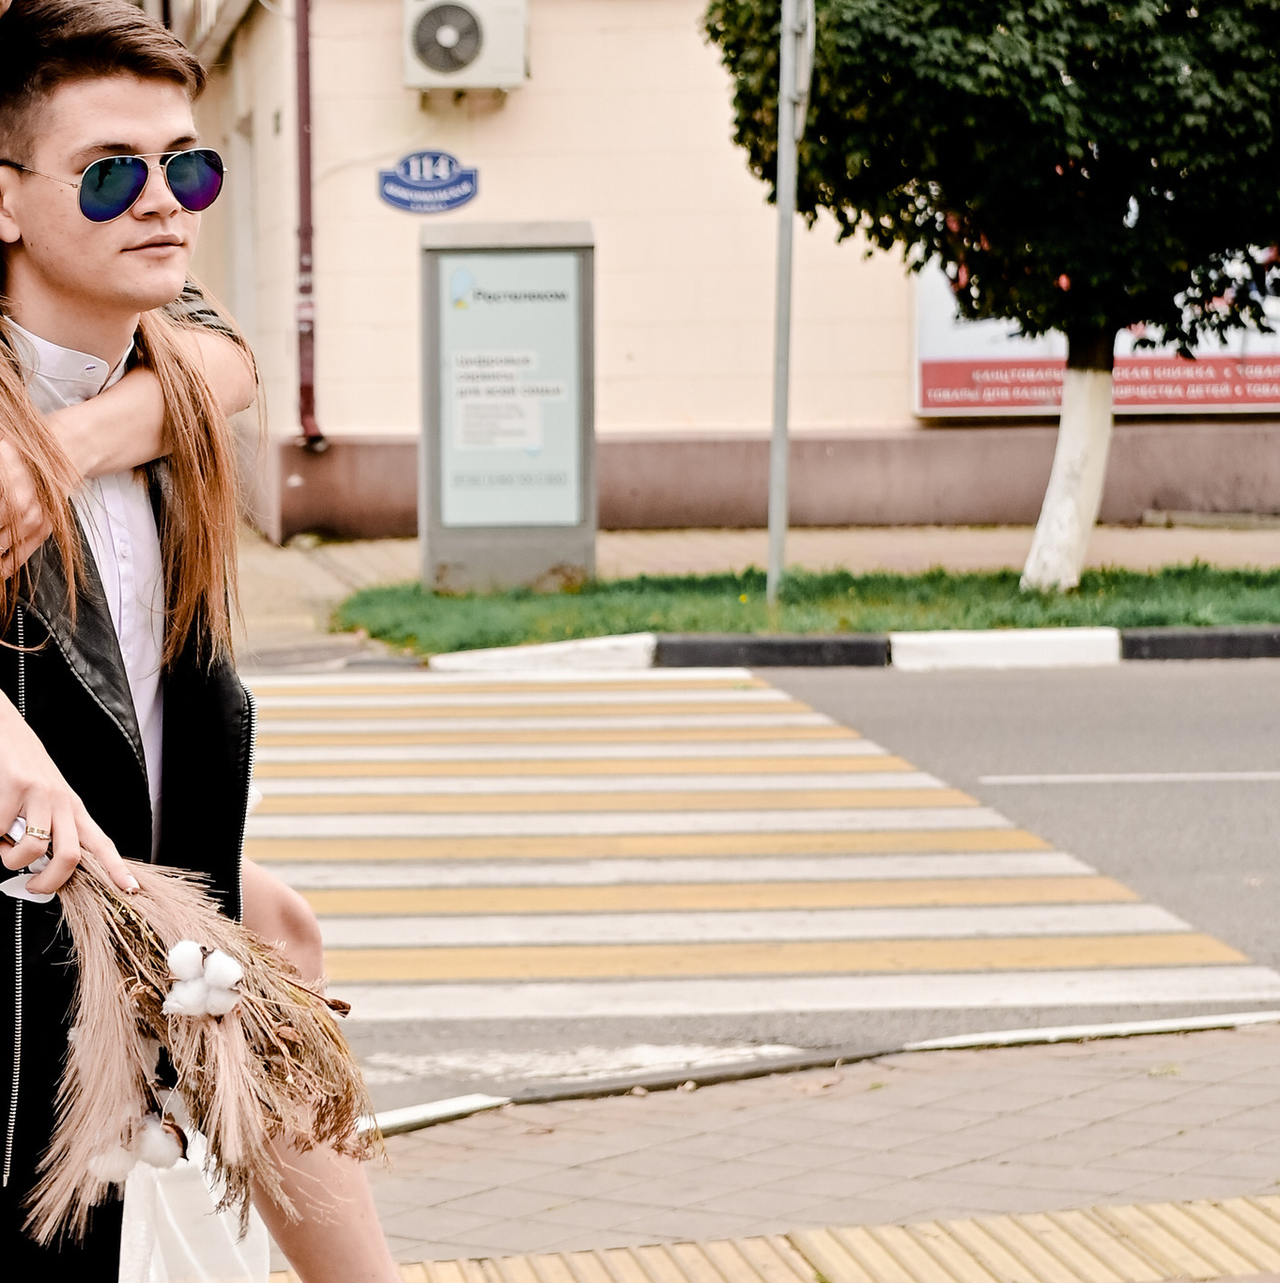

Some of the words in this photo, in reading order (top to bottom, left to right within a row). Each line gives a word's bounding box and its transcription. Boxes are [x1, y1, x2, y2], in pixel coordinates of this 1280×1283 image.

[408, 155, 451, 181] 114
[472, 288, 568, 304] Ростелеком
[1153, 365, 1215, 379] КНИЖКА
[1236, 364, 1280, 378] ТОВАР
[927, 388, 979, 402] ТОВАРЫ
[982, 387, 1010, 402] ДЛЯ
[1012, 386, 1062, 400] РАЗВИТ
[1112, 384, 1184, 399] ОРЧЕСТВА
[1186, 382, 1231, 398] ДЕТЕЙ
[1246, 383, 1280, 397] ТОВА
